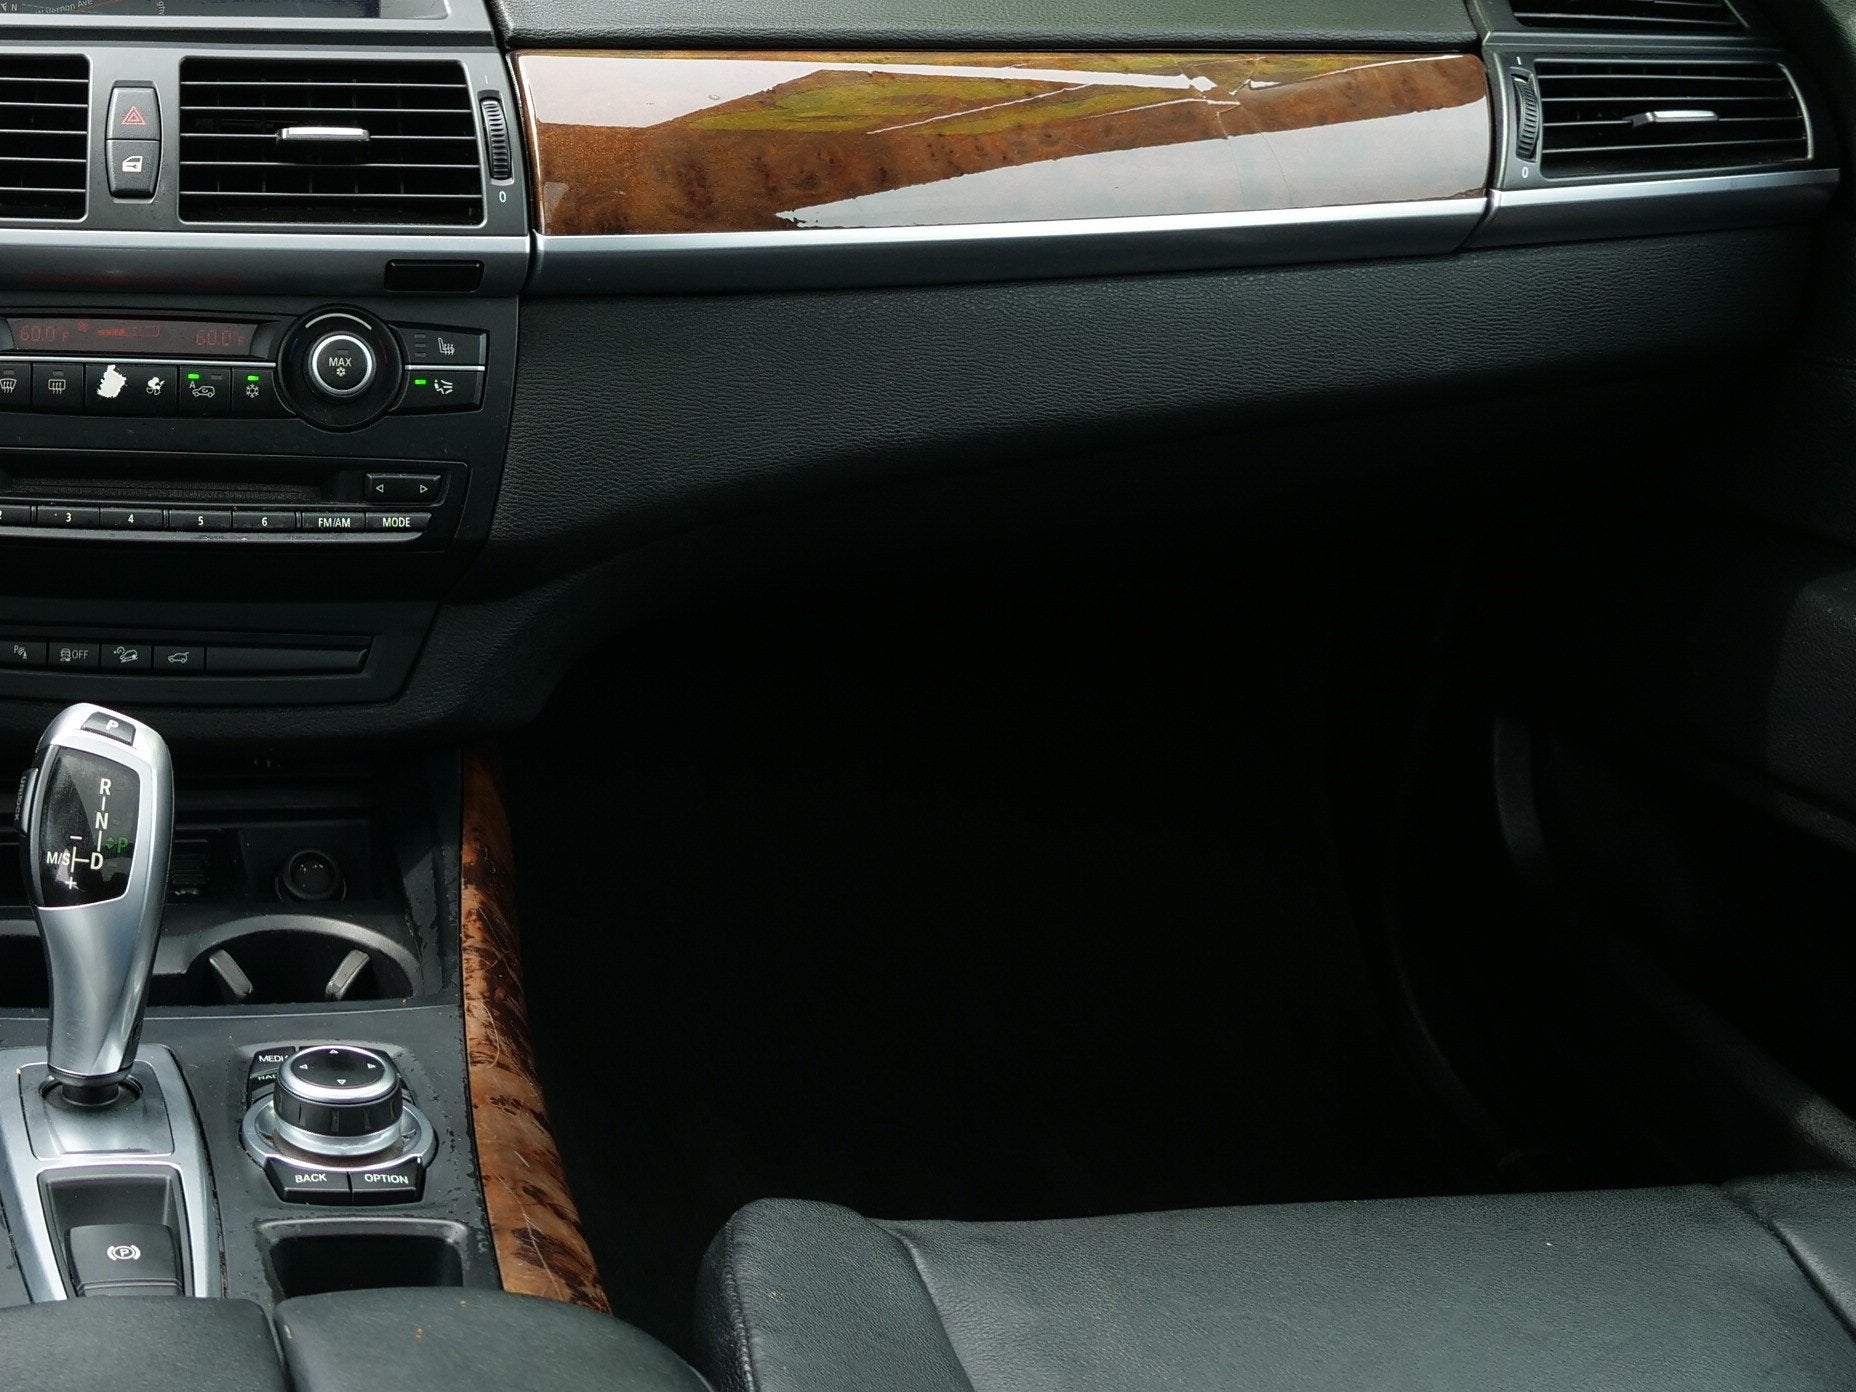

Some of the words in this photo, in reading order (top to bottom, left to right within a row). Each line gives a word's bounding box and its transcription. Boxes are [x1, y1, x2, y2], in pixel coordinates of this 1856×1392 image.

[328, 357, 352, 367] MAX
[65, 512, 72, 522] 3
[128, 513, 134, 523] 4
[198, 516, 204, 526] 5
[261, 517, 267, 526] 6
[318, 517, 351, 528] FM/AM
[382, 517, 411, 528] MODE
[72, 649, 89, 659] OFF
[105, 720, 119, 730] P
[99, 778, 112, 796] R
[95, 812, 109, 830] N
[117, 836, 129, 854] P
[46, 851, 70, 865] M/S
[90, 852, 104, 870] D
[295, 1173, 327, 1183] BACK
[364, 1174, 409, 1184] OPTION
